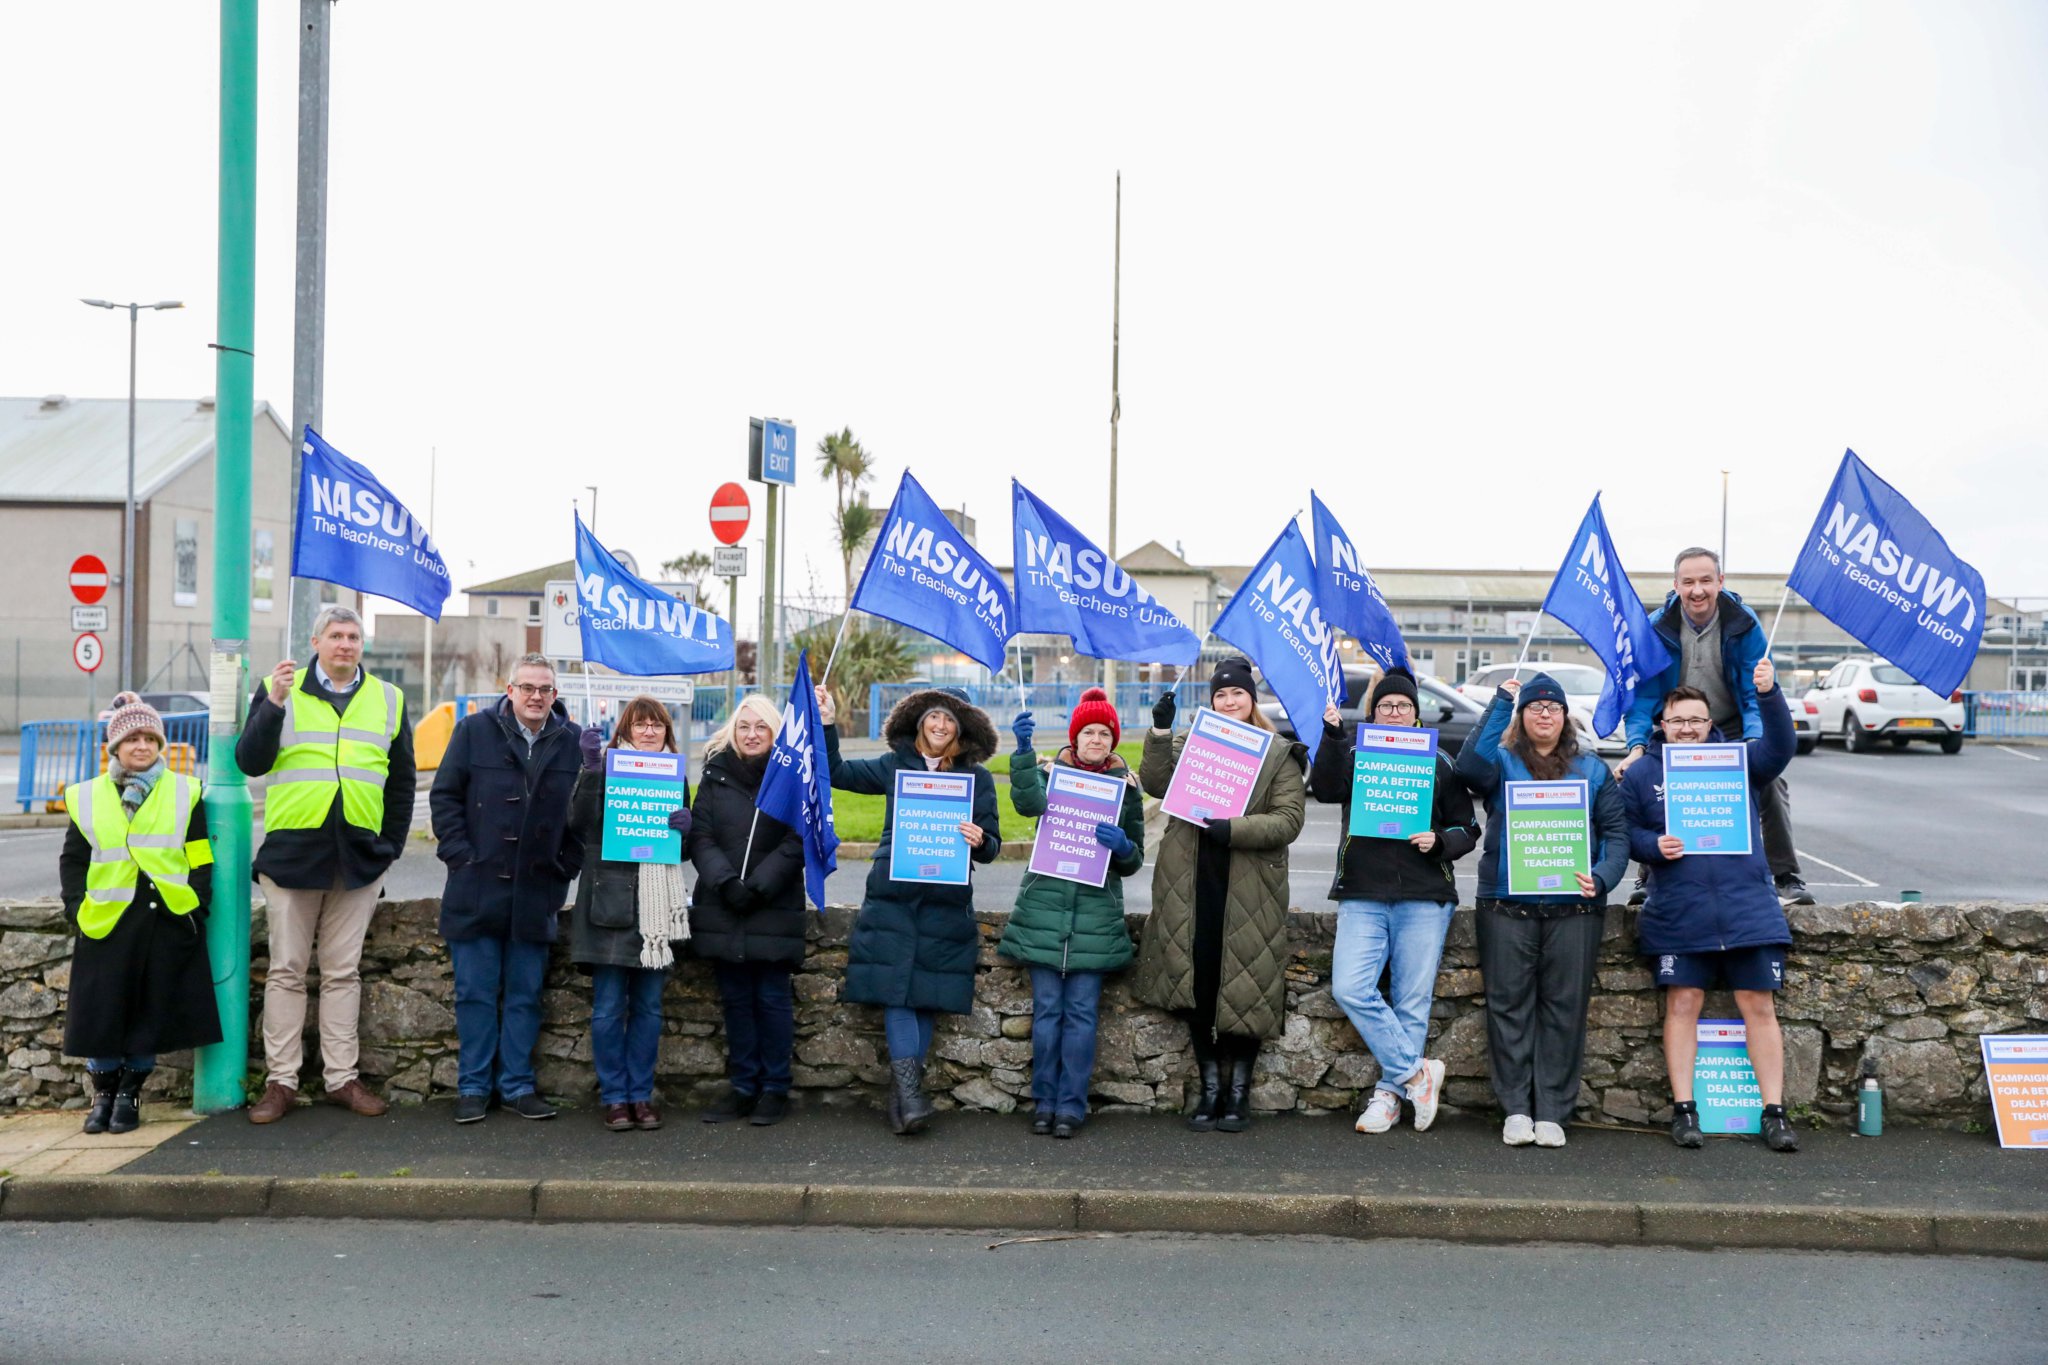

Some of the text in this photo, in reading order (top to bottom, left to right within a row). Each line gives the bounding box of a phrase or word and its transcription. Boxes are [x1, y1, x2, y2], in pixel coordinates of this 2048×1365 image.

[773, 432, 787, 451] NO
[770, 454, 789, 472] EXIT
[311, 474, 438, 554] NASUW
[312, 516, 336, 535] The
[338, 523, 410, 556] Teachers'
[717, 551, 743, 563] Except
[718, 562, 741, 572] buses
[1024, 529, 1165, 606] NASU
[1823, 501, 1977, 632] NASUWT
[1027, 570, 1055, 587] Th
[1332, 570, 1361, 592] The
[1575, 567, 1599, 596] The
[882, 554, 1003, 642] The Teachers' Unio
[1817, 536, 1964, 648] The Teachers' Union
[1249, 592, 1275, 623] The
[84, 644, 92, 660] 5
[1189, 745, 1255, 775] CAMPAIGNING
[1186, 757, 1205, 770] FOR
[1215, 768, 1248, 787] BETTER
[1356, 761, 1433, 775] CAMPAIGNING
[1190, 773, 1235, 795] DEAL FOR
[1357, 775, 1378, 783] FOR
[1391, 777, 1430, 788] BETTER
[1670, 782, 1743, 790] CAMPAIGNING
[607, 786, 681, 799] CAMPAIGNING
[1185, 784, 1231, 808] TEACHERS
[1367, 789, 1418, 800] DEAL FOR
[608, 800, 628, 809] FOR
[641, 802, 679, 812] BETTER
[1364, 802, 1418, 814] TEACHERS
[1683, 807, 1709, 815] DEAL
[618, 814, 668, 825] DEAL FOR
[899, 809, 967, 820] CAMPAIGNING
[1048, 803, 1113, 823] CAMPAIGNING
[900, 822, 919, 830] FOR
[931, 824, 960, 832] BETTE
[1047, 816, 1097, 832] FOR A BETT
[1512, 820, 1584, 829] CAMPAIGNING
[1682, 820, 1734, 828] TEACHERS
[616, 827, 669, 838] TEACHERS
[1053, 830, 1097, 846] DEAL FOR
[1546, 833, 1582, 841] BETTER
[909, 835, 955, 844] DEAL FOR
[907, 847, 955, 857] TEACHERS
[1049, 841, 1096, 859] TEACHERS
[1524, 859, 1574, 867] TEACHERS
[1696, 1071, 1755, 1079] FOR A BETT
[1993, 1074, 2048, 1082] CAMPAIGN
[1707, 1084, 1760, 1093] DEAL FOR
[1997, 1087, 2019, 1095] FOR
[2031, 1087, 2048, 1095] BET
[1706, 1098, 1763, 1107] TEACHERS
[2011, 1100, 2039, 1108] DEAL
